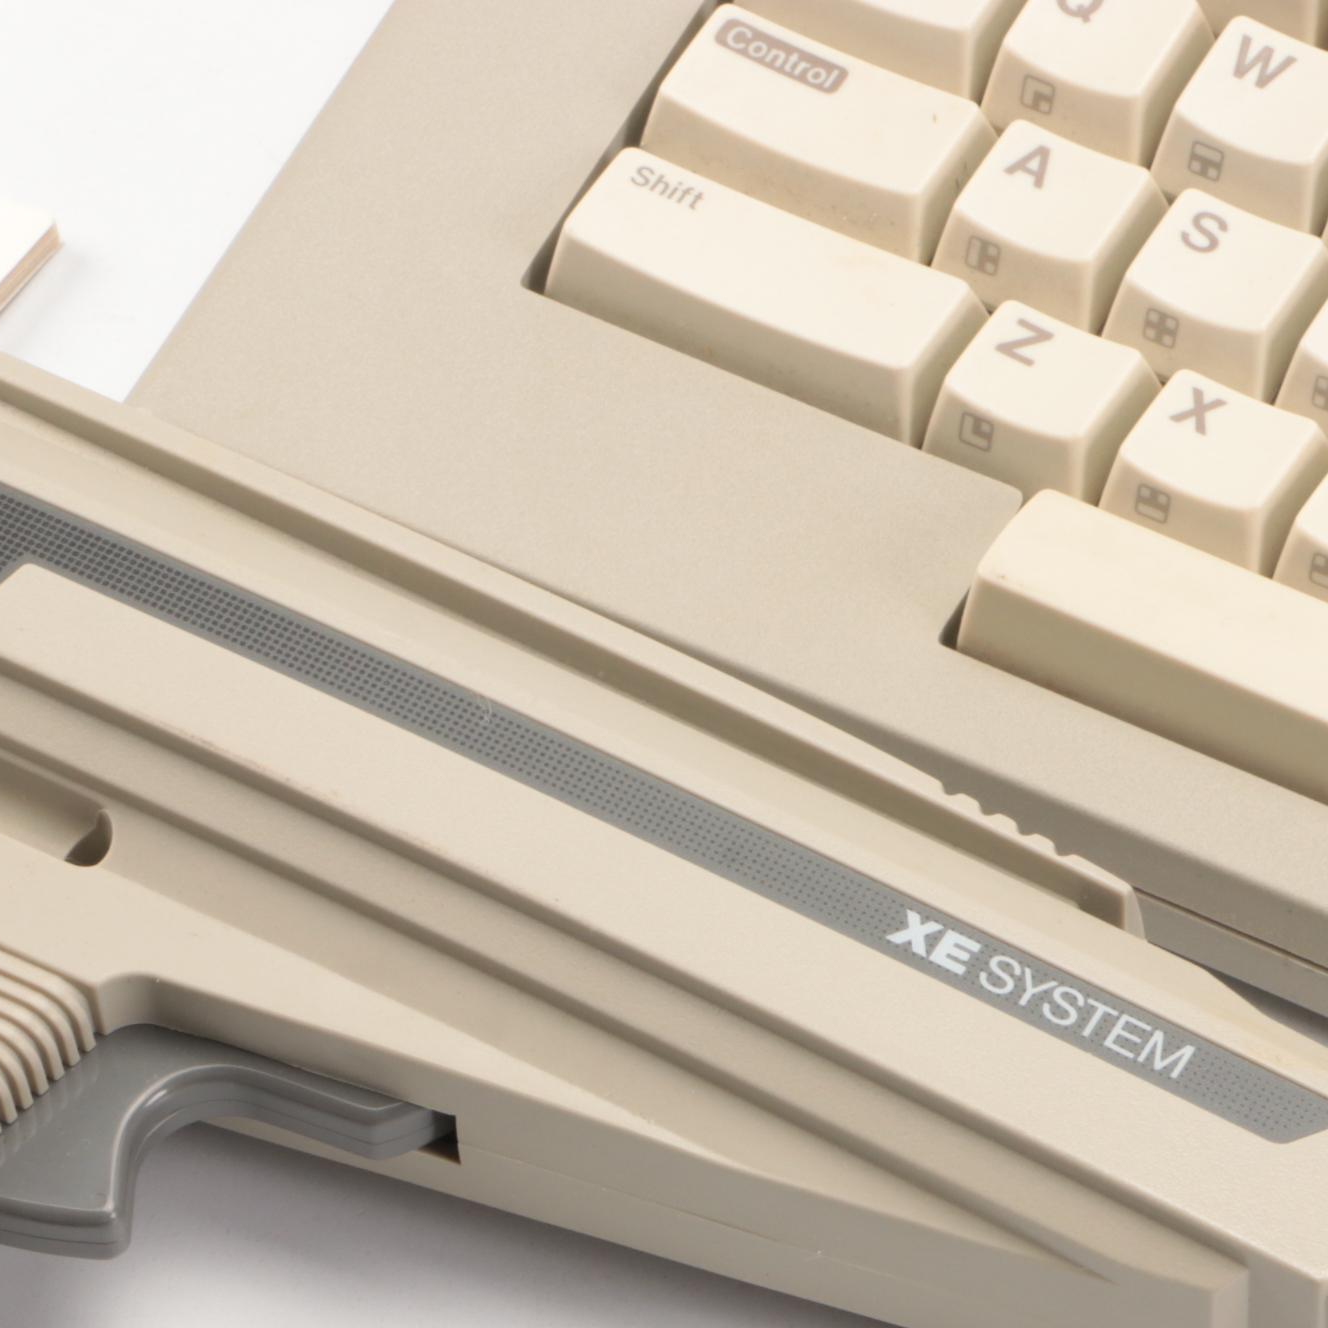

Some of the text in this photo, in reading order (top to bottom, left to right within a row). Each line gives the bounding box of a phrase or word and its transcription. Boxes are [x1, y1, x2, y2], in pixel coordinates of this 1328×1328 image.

[725, 25, 841, 92] Control
[1232, 34, 1297, 90] W
[629, 164, 705, 212] Shift
[1004, 145, 1052, 189] A
[1179, 211, 1230, 254] S
[995, 317, 1055, 367] Z
[1168, 386, 1227, 435] X
[887, 909, 1197, 1079] XE SYSTEM
